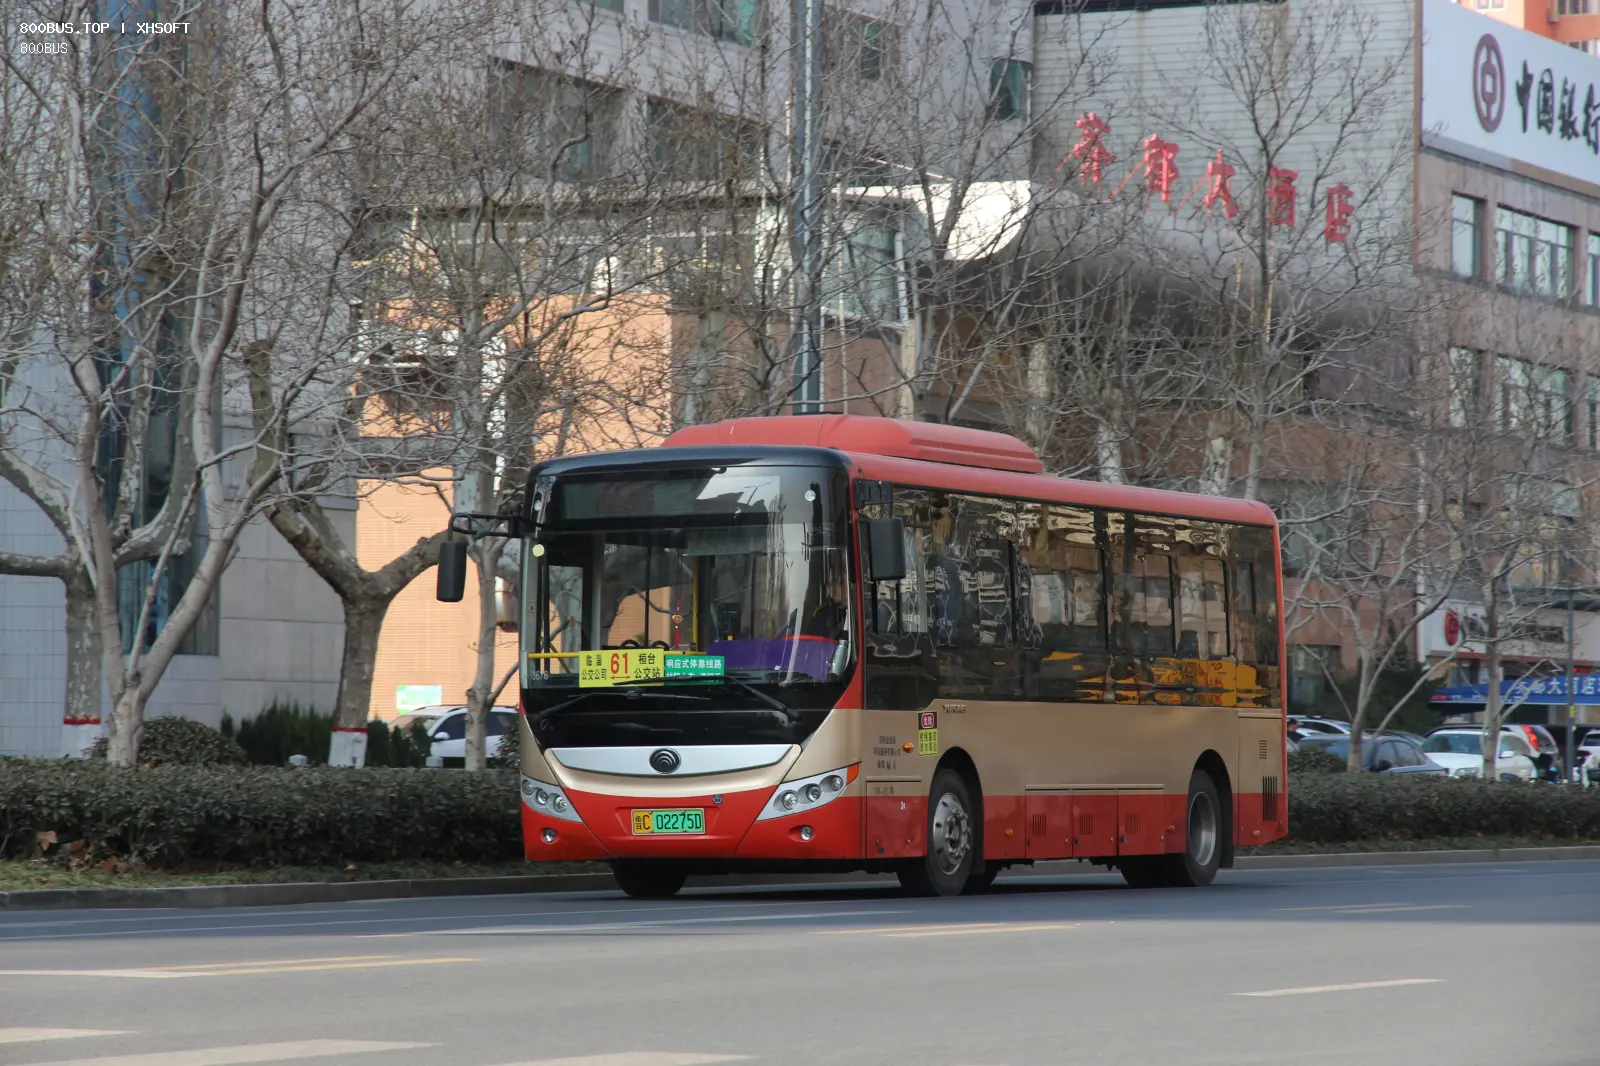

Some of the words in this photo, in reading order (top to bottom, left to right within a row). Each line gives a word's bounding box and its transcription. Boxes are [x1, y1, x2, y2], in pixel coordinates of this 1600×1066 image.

[610, 652, 629, 674] 61
[638, 652, 656, 665] 桓台
[666, 659, 722, 669] 响应式停靠线路
[581, 668, 607, 681] 公交公司
[634, 667, 661, 679] 公交站
